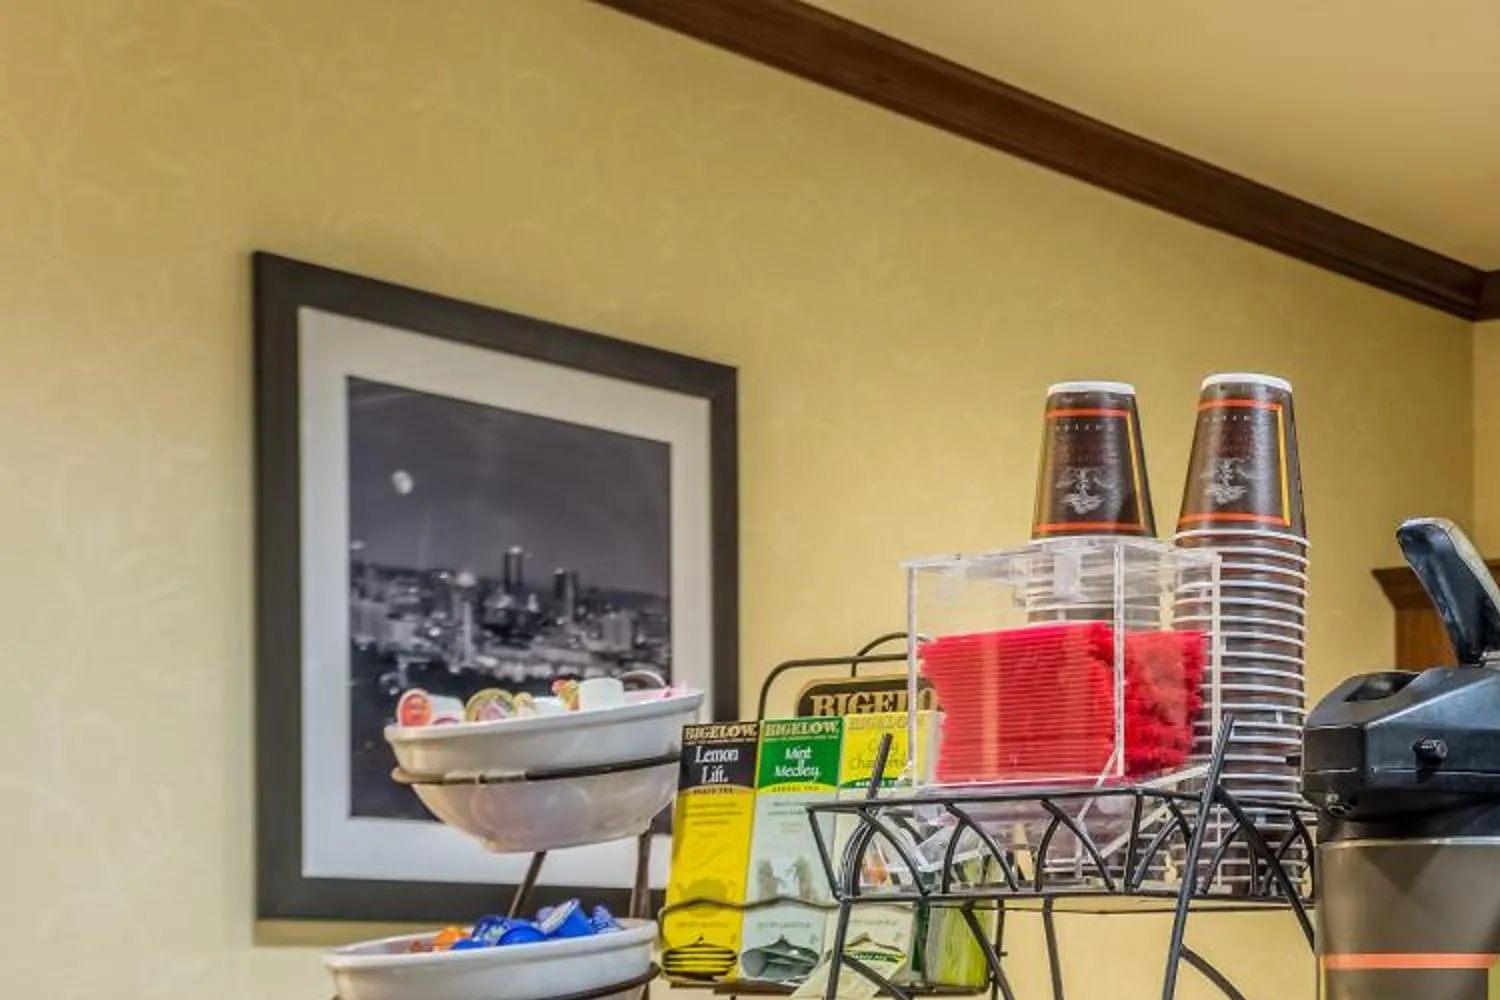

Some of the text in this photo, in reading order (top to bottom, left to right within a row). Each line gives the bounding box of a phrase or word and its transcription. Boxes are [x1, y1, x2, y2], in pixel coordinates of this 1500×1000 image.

[685, 724, 755, 739] BIGELOW
[695, 746, 739, 763] Lemon
[785, 746, 813, 760] Mint
[701, 766, 728, 783] Lift
[774, 762, 820, 783] Medley
